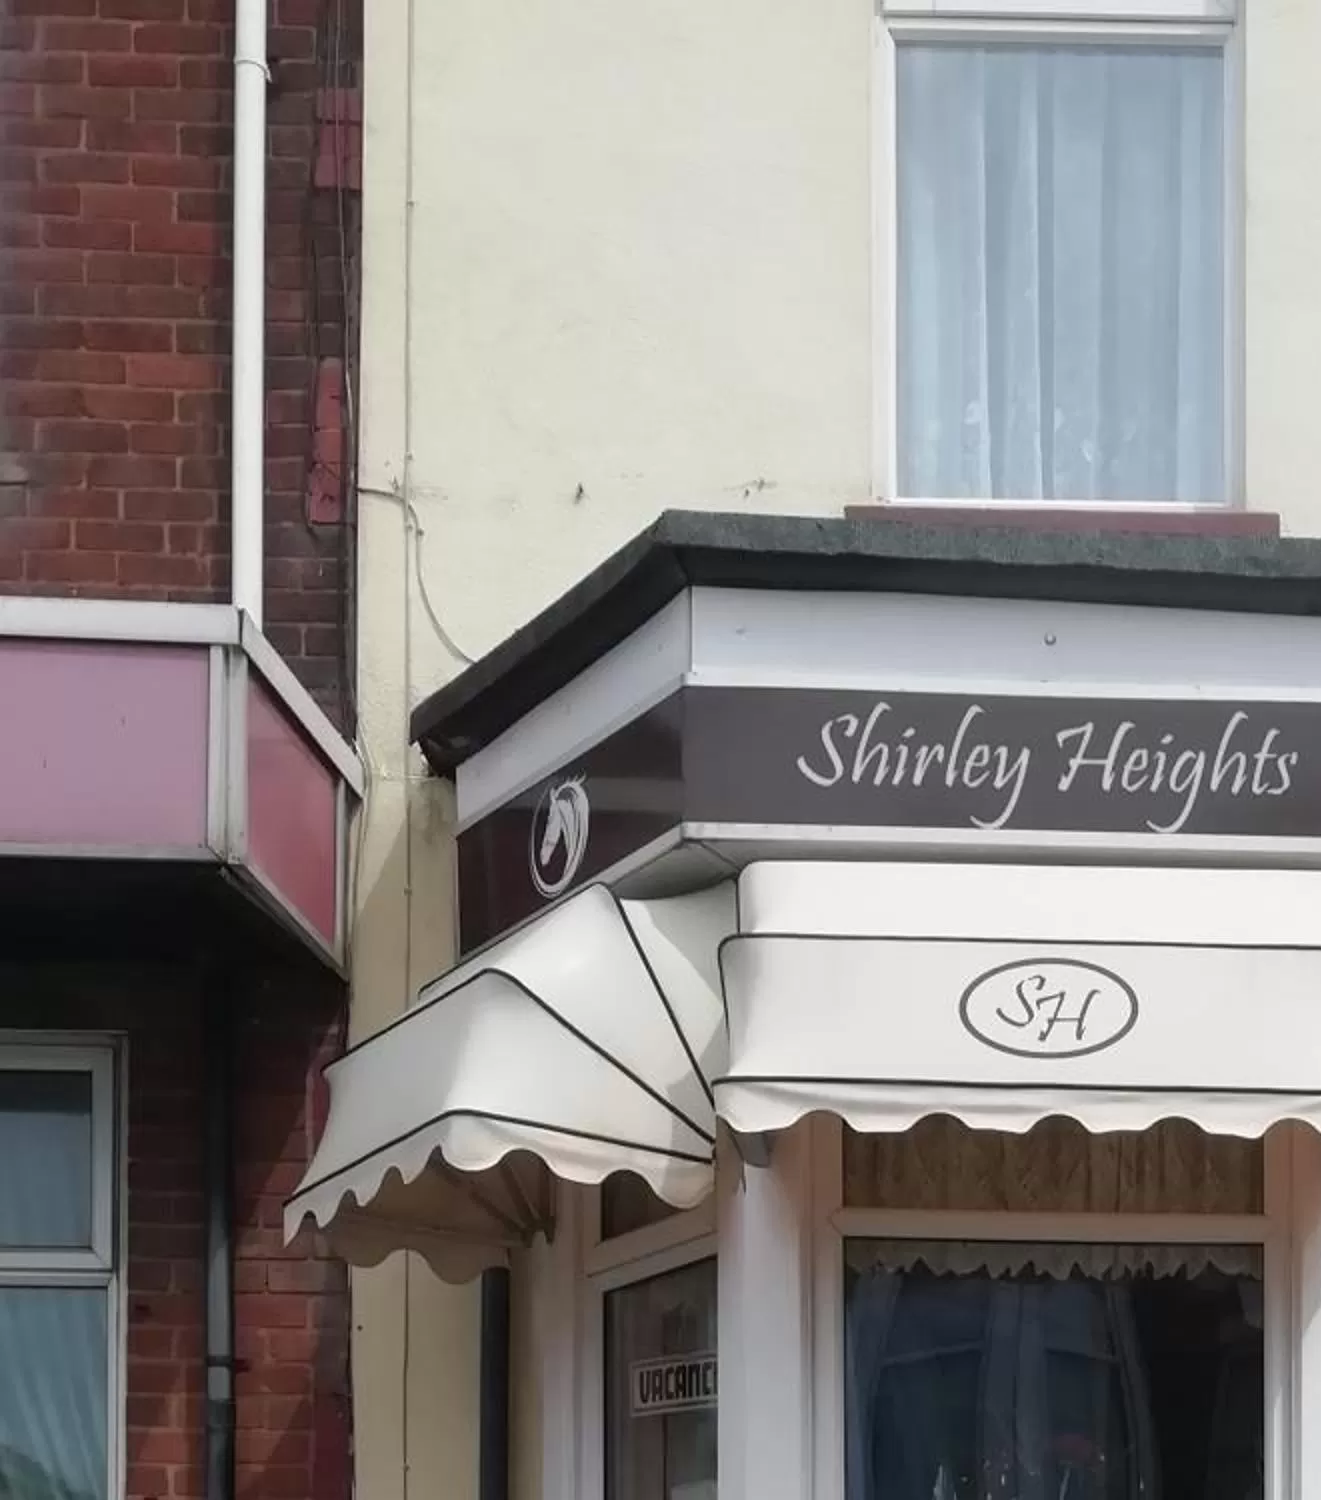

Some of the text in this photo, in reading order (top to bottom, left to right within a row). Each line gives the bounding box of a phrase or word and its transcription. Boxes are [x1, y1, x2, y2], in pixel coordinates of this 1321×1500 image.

[797, 701, 1299, 835] Shirley Heights
[996, 974, 1101, 1042] SH
